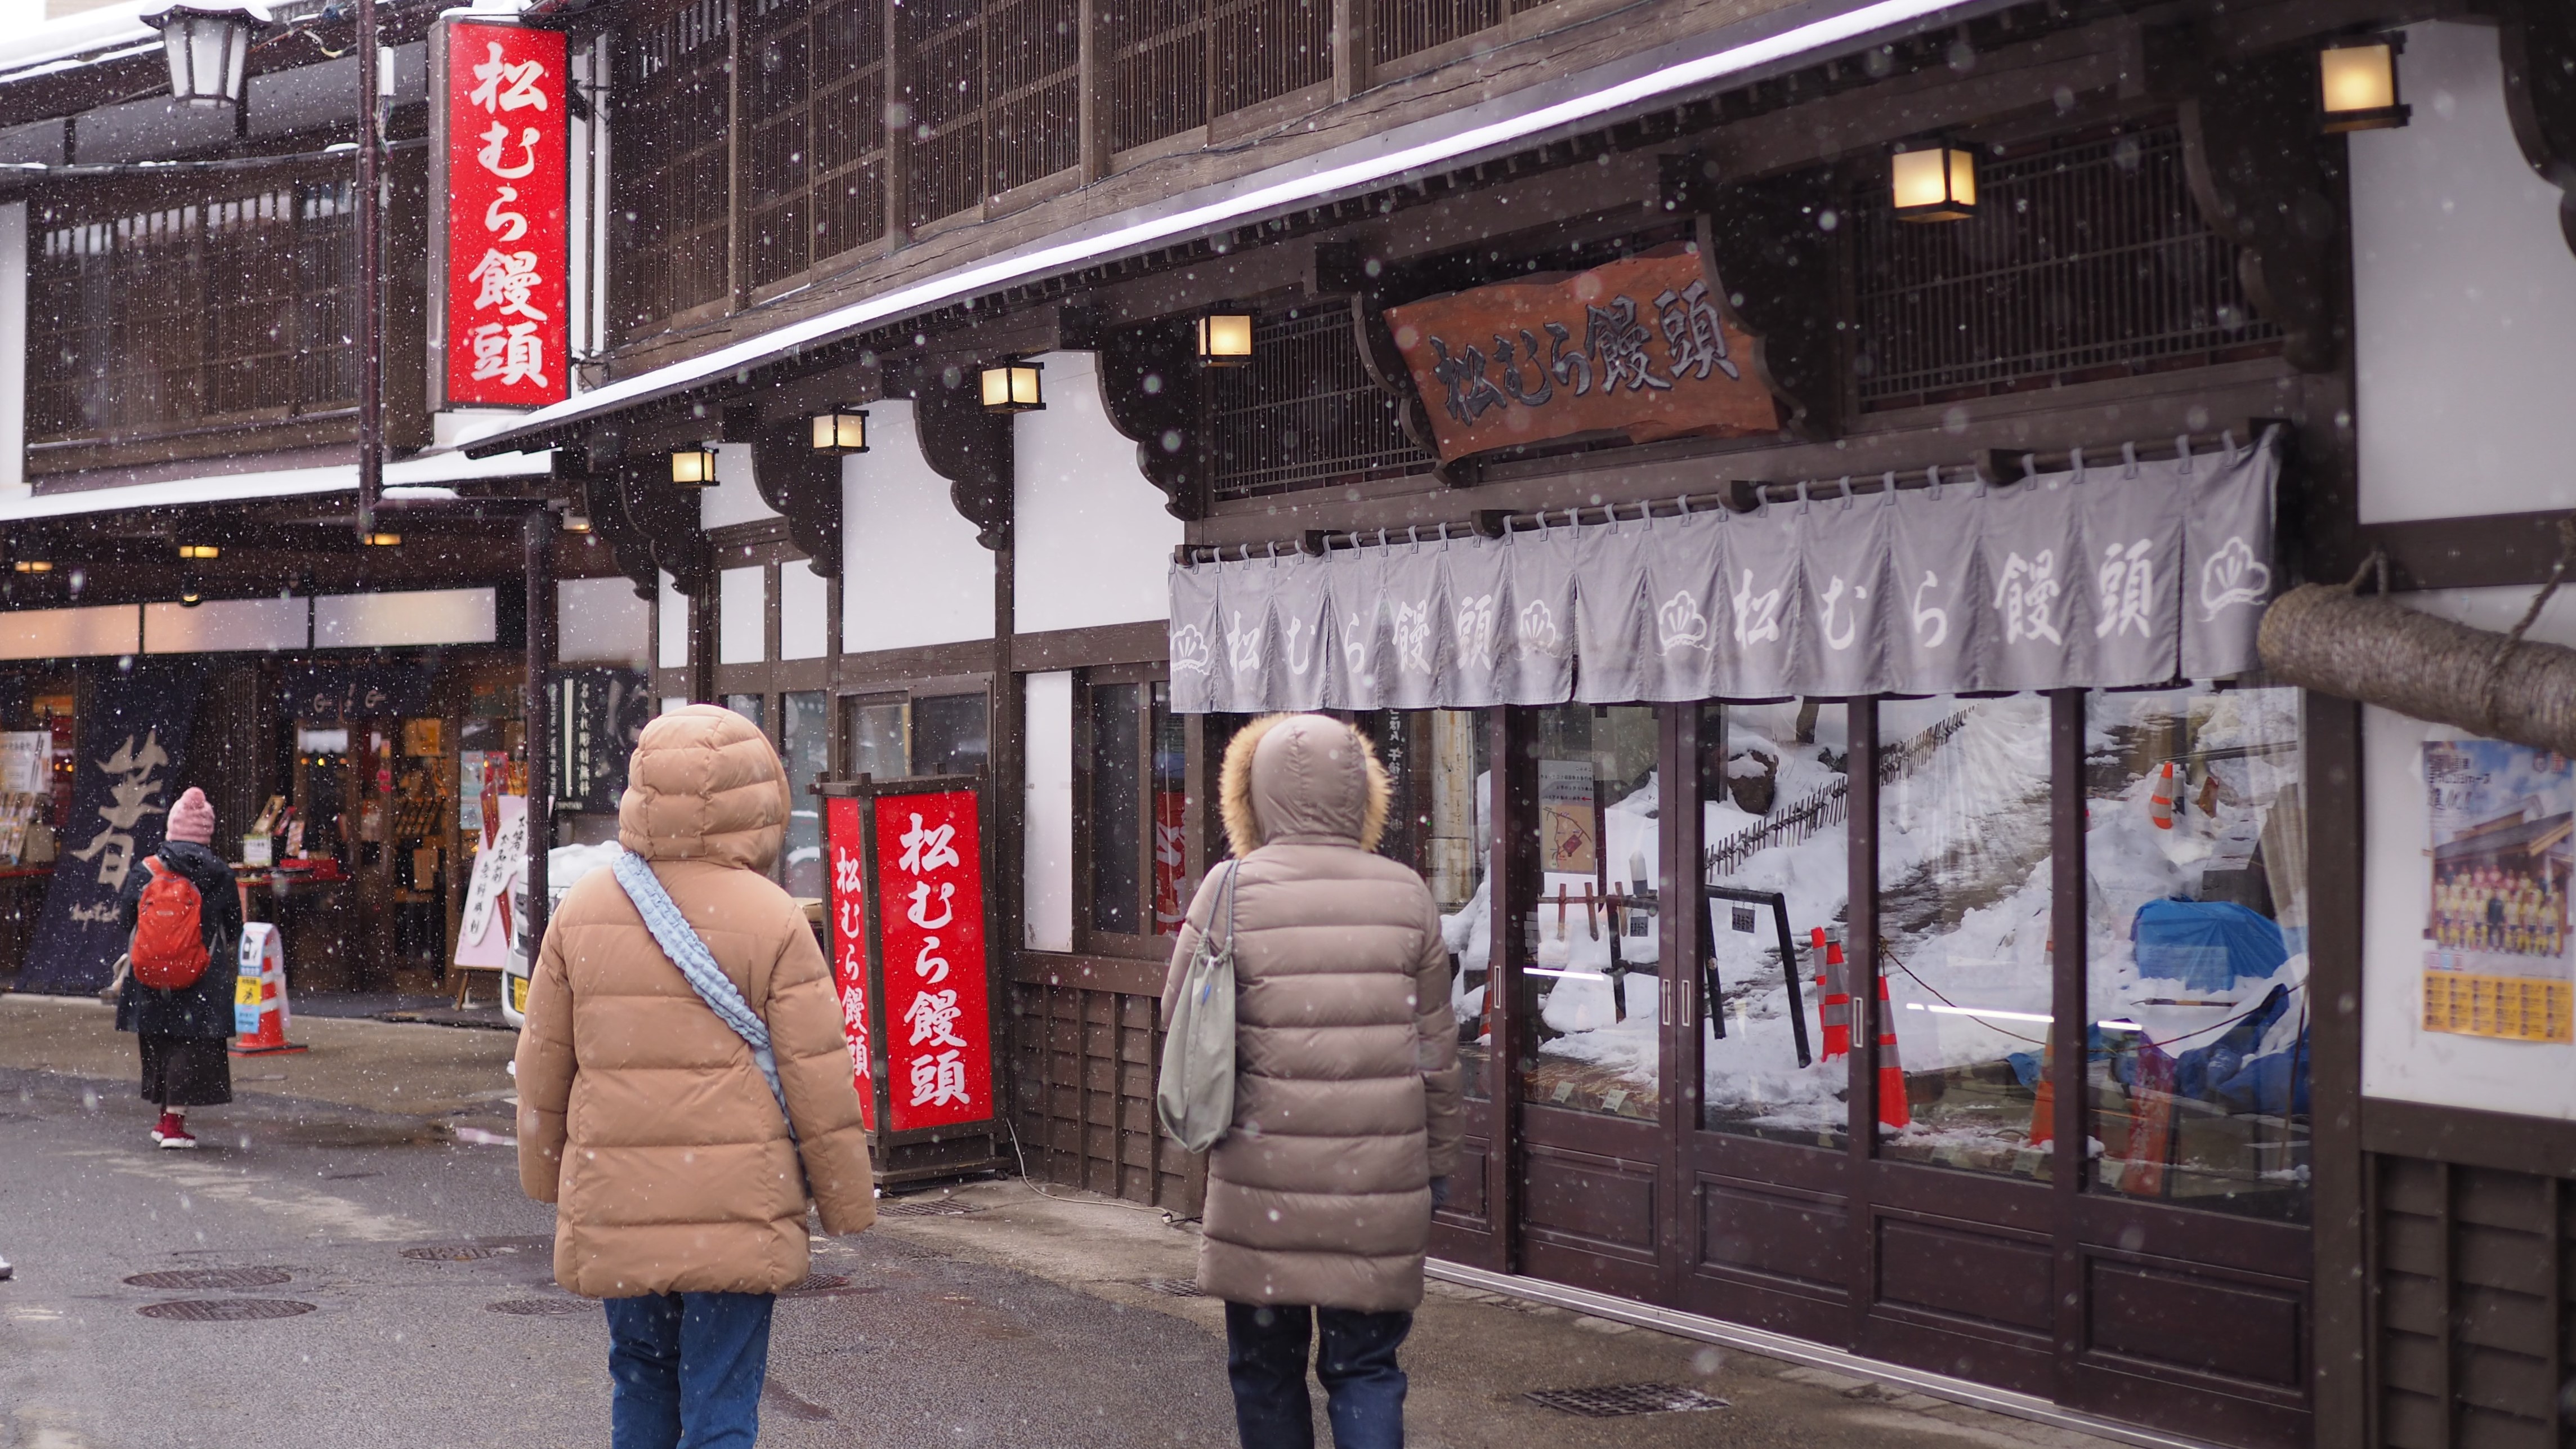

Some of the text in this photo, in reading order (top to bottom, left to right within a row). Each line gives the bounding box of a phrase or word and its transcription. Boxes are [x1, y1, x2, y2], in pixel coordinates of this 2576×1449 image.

[468, 42, 548, 388] 松むら饅頭
[1428, 280, 1740, 426] 松むら饅頭
[1226, 594, 1492, 675] 松むら饅頭
[1734, 539, 2153, 650] 松むら饅頭
[70, 730, 168, 893] 箸
[837, 847, 870, 1080] 松むら饅頭
[899, 813, 971, 1107] 松むら饅頭
